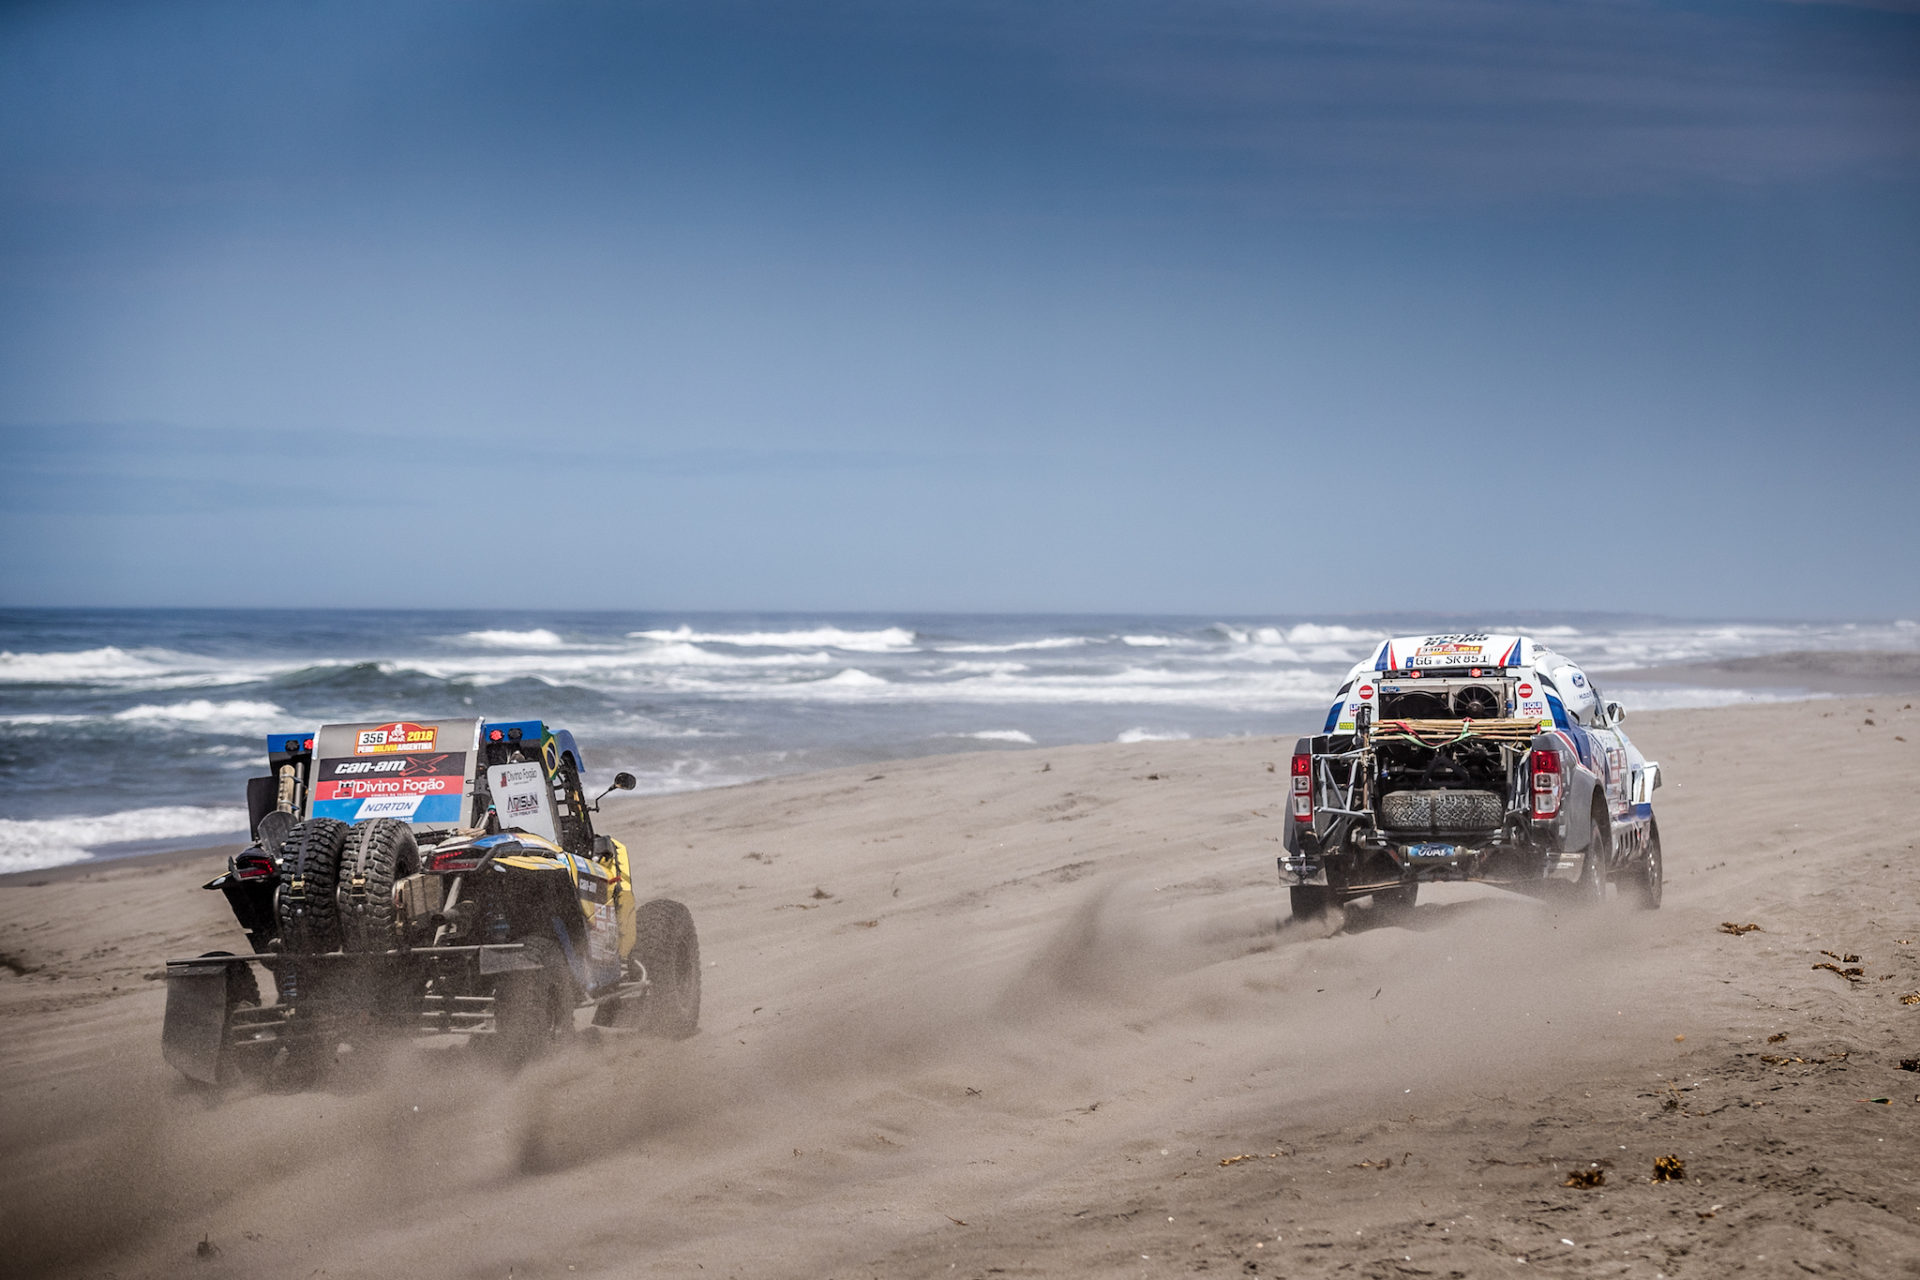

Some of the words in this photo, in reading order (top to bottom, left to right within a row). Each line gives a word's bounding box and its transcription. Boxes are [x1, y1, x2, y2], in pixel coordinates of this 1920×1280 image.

[1415, 656, 1432, 666] GG
[362, 732, 384, 744] 356
[406, 730, 434, 742] 2018
[355, 780, 400, 793] Divino
[403, 778, 445, 793] Fogão
[364, 801, 414, 812] NORTON
